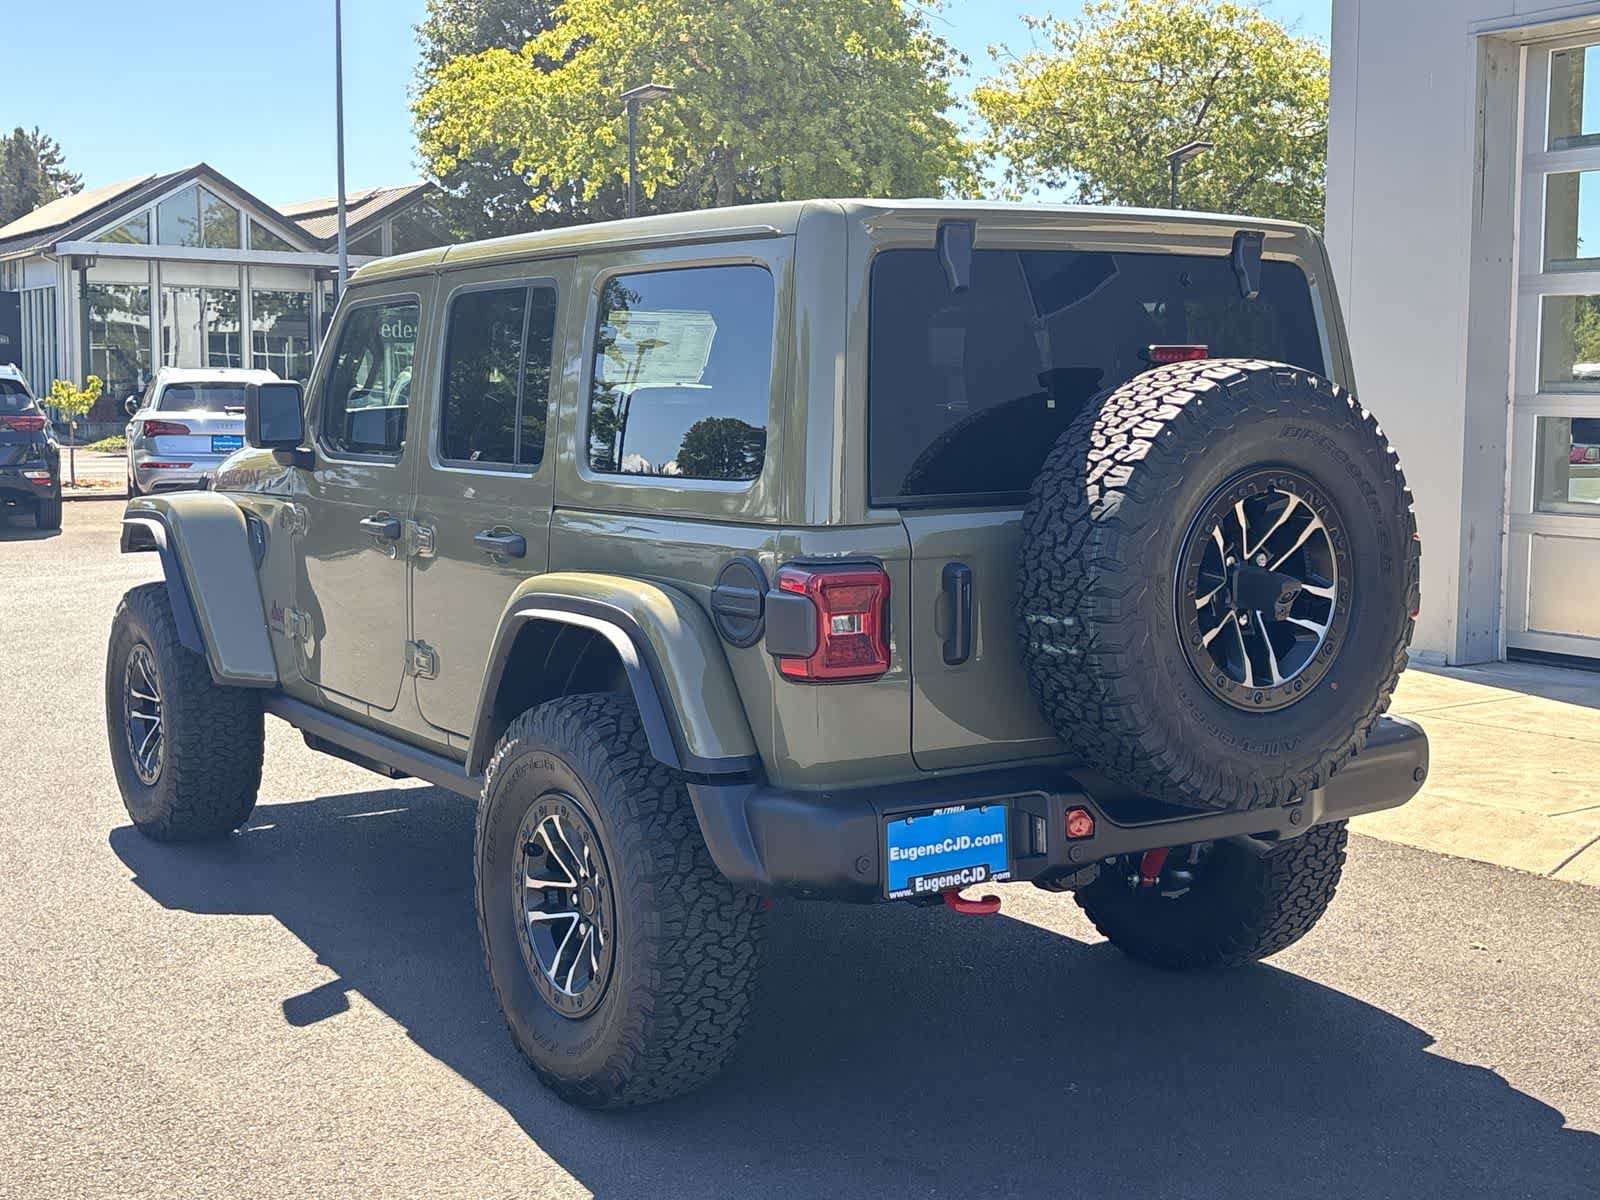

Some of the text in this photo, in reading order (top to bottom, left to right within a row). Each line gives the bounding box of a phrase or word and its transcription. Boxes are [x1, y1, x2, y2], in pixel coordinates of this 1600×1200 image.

[889, 833, 1003, 861] EugeneCJD.com
[889, 888, 914, 899] www.
[915, 866, 986, 892] EugeneCJD
